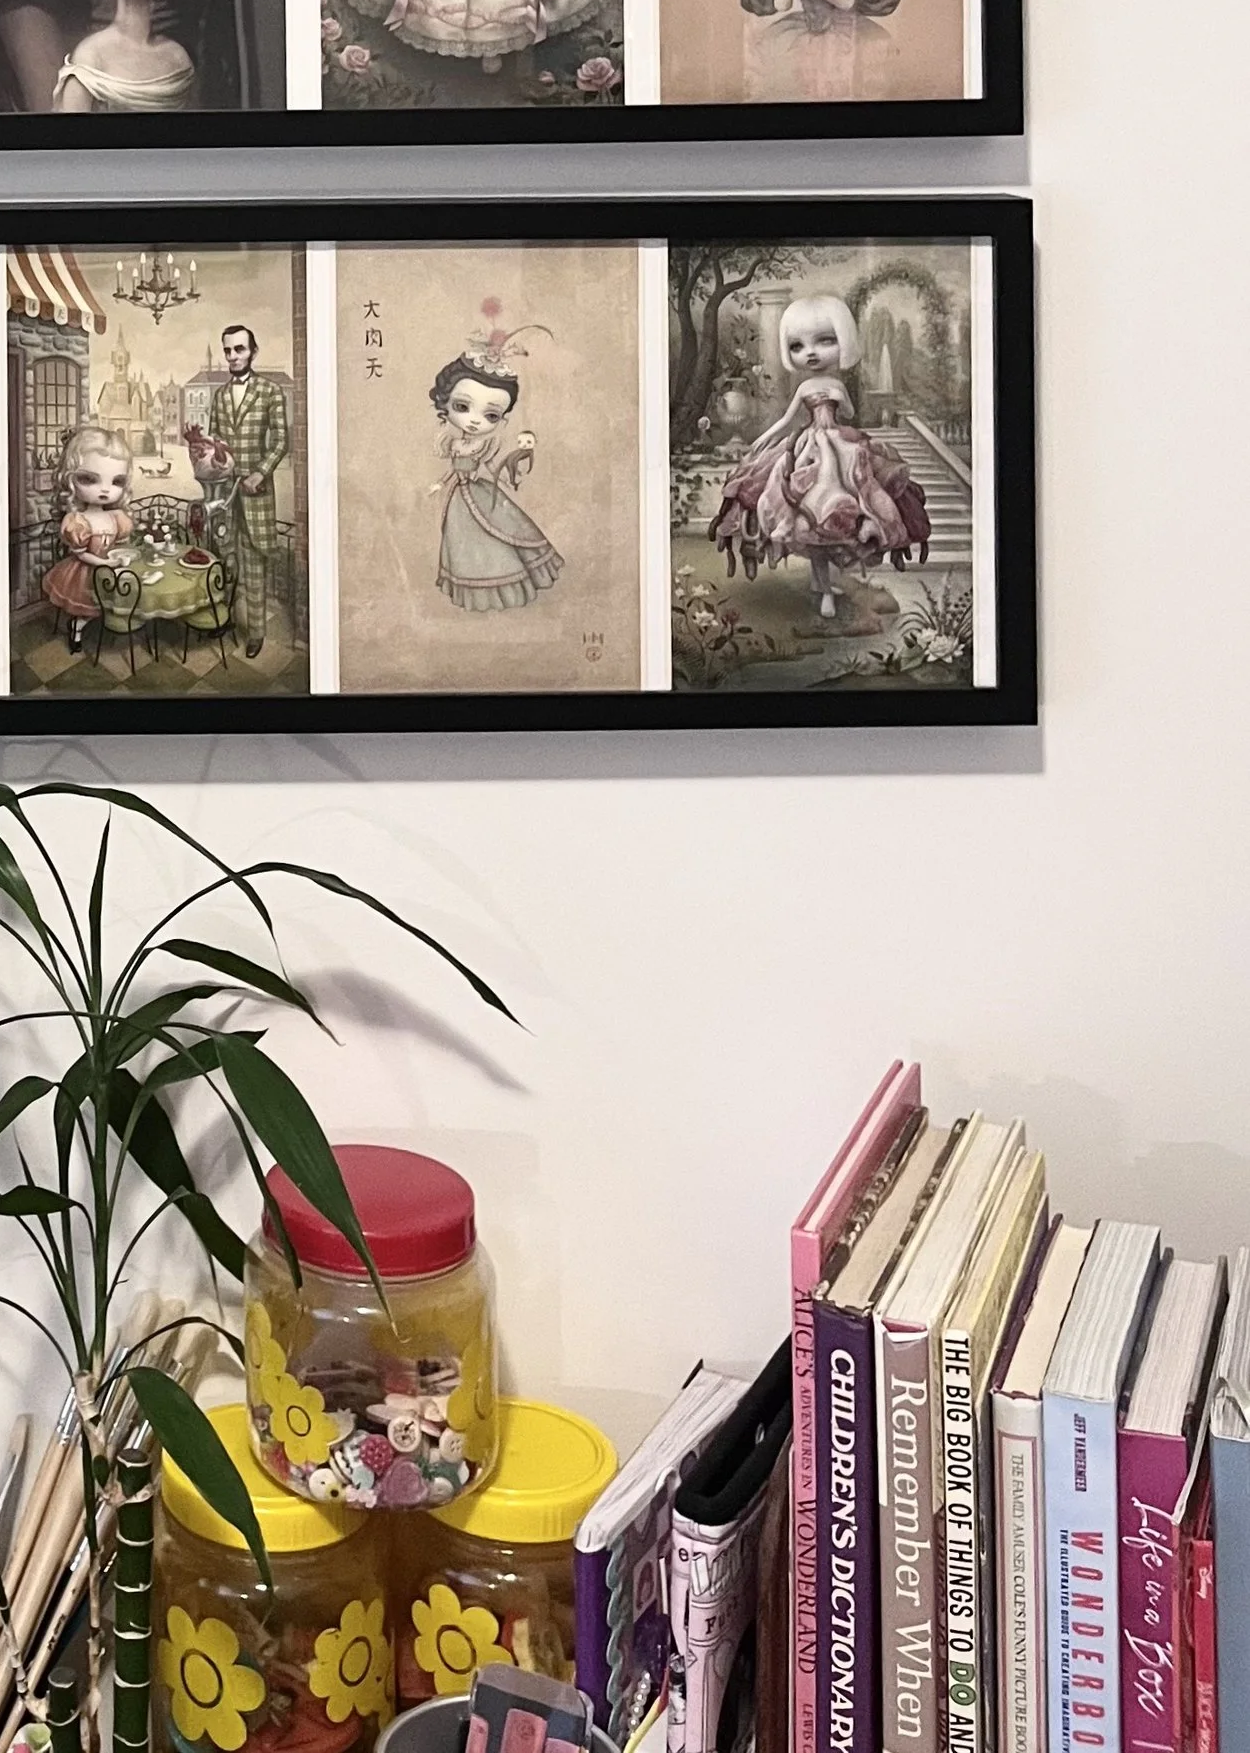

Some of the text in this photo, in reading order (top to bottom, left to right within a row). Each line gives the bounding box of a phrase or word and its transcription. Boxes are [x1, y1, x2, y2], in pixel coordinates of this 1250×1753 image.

[794, 1287, 815, 1379] ALICE'S
[945, 1338, 971, 1376] THE
[800, 1386, 813, 1471] ADVENTURES
[946, 1384, 972, 1423] BIG
[946, 1433, 973, 1494] BOOK
[1073, 1413, 1087, 1492] JEFF VANDERMEER
[802, 1475, 812, 1492] IN
[948, 1503, 973, 1530] OF
[1060, 1529, 1069, 1544] THE
[830, 1348, 858, 1753] CHILDREN'S DICTIONARY
[890, 1374, 933, 1739] Remember When
[949, 1539, 974, 1618] THINGS
[1060, 1548, 1069, 1606] ILLUSTRATED
[797, 1498, 817, 1675] WONDERLAND
[1011, 1454, 1028, 1753] THE FAMILY AMUSER COLE'S FUNNY PICTURE BOO
[1122, 1497, 1175, 1719] Life in a Box
[949, 1628, 974, 1653] TO
[1061, 1638, 1069, 1649] TO
[1071, 1531, 1105, 1746] WONDERBO
[949, 1660, 978, 1707] DO
[1061, 1652, 1070, 1695] CREATING
[803, 1704, 814, 1741] LEWIS
